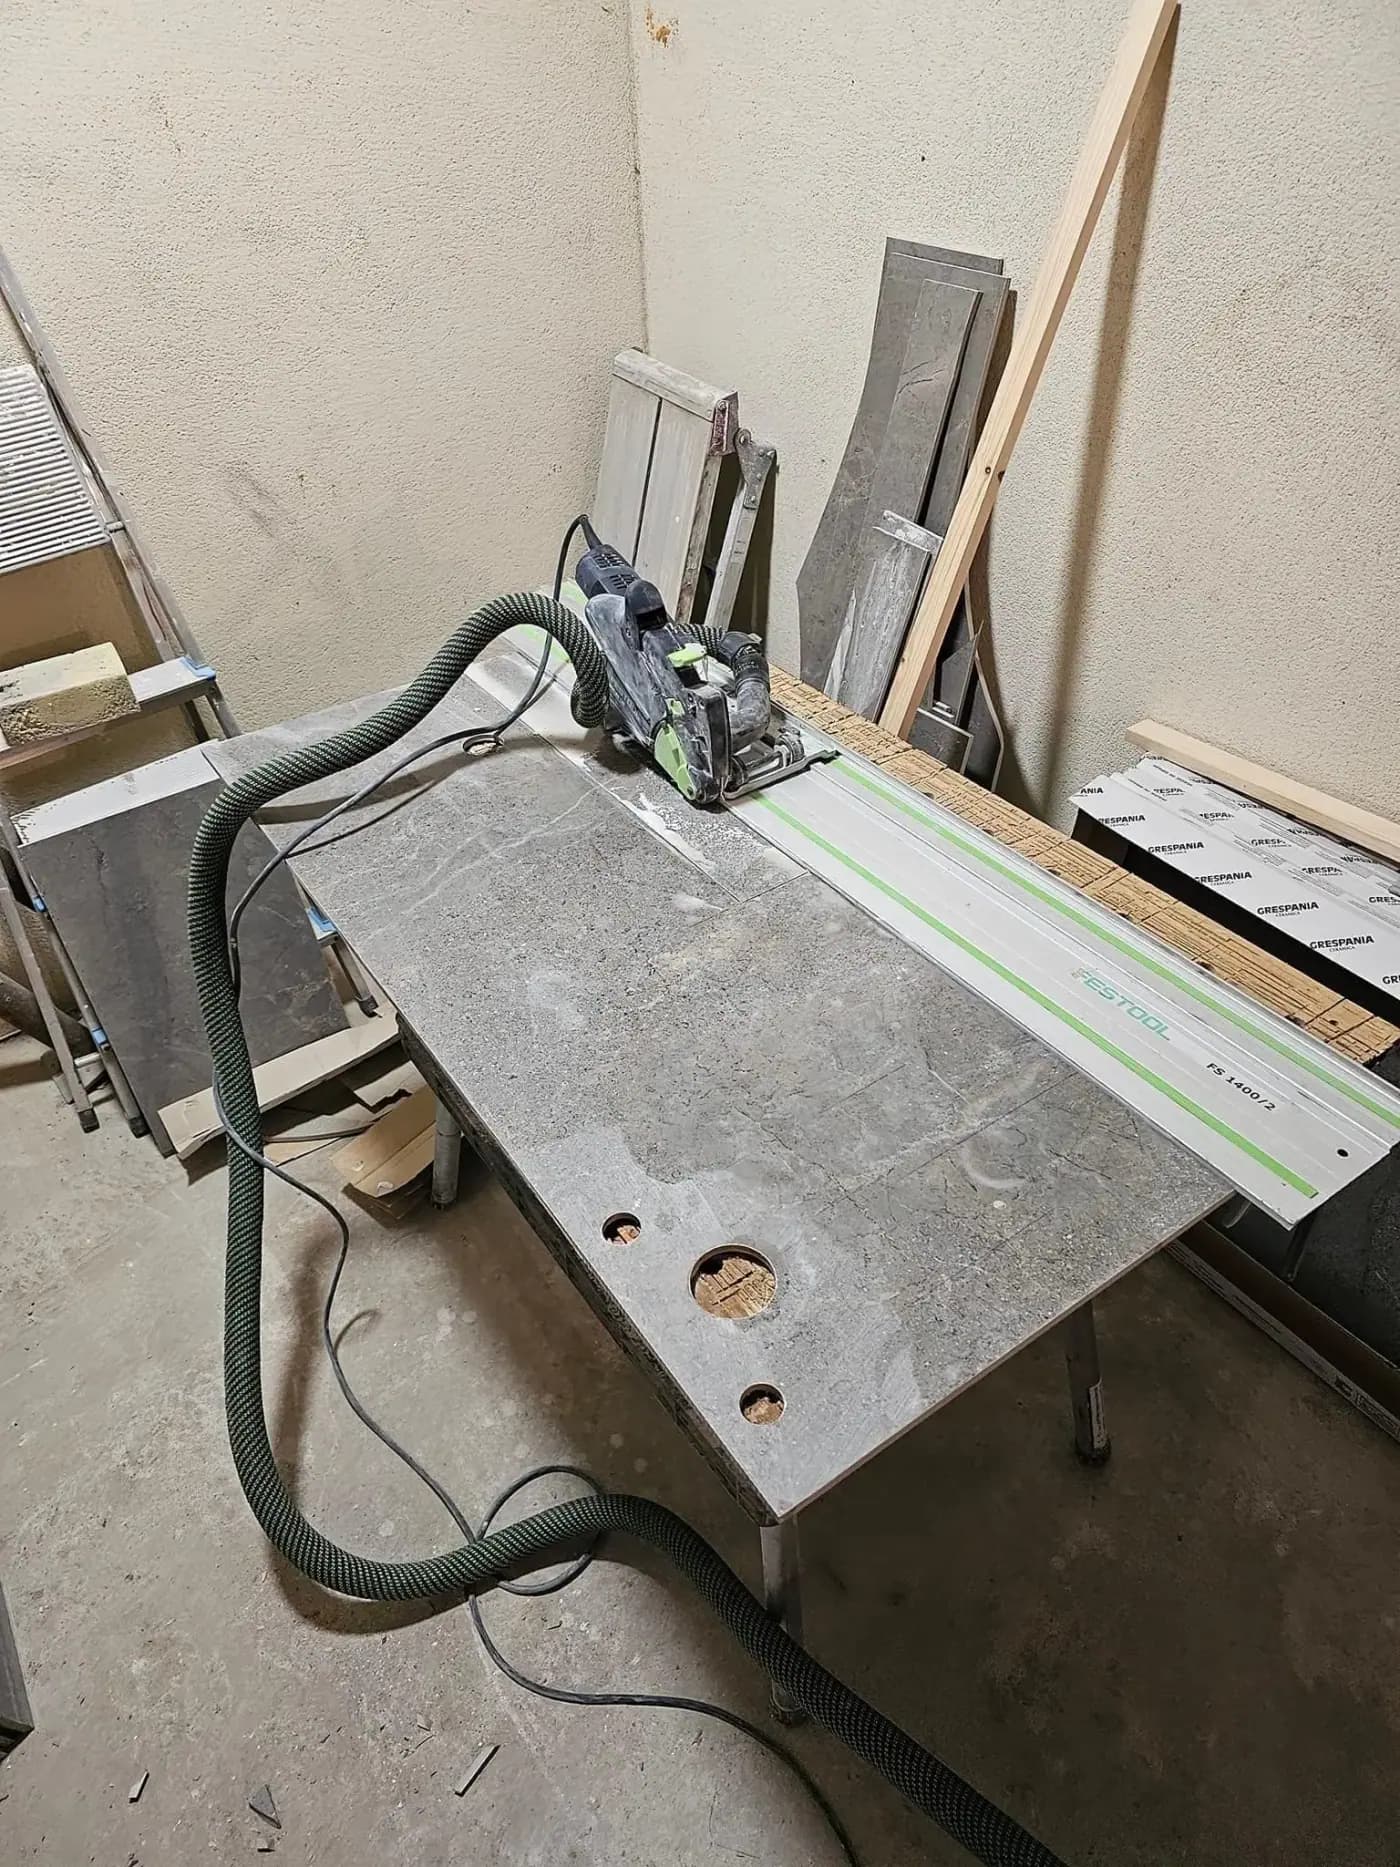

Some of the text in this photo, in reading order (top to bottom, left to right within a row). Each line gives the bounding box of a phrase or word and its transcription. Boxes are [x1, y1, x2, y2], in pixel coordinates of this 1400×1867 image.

[1148, 842, 1205, 855] GRESPANIA
[1195, 871, 1253, 884] RESPANIA
[1257, 902, 1320, 915] GRESPANIA
[1309, 935, 1375, 950] GRESPANIA
[1206, 1063, 1277, 1112] FS 1400/2
